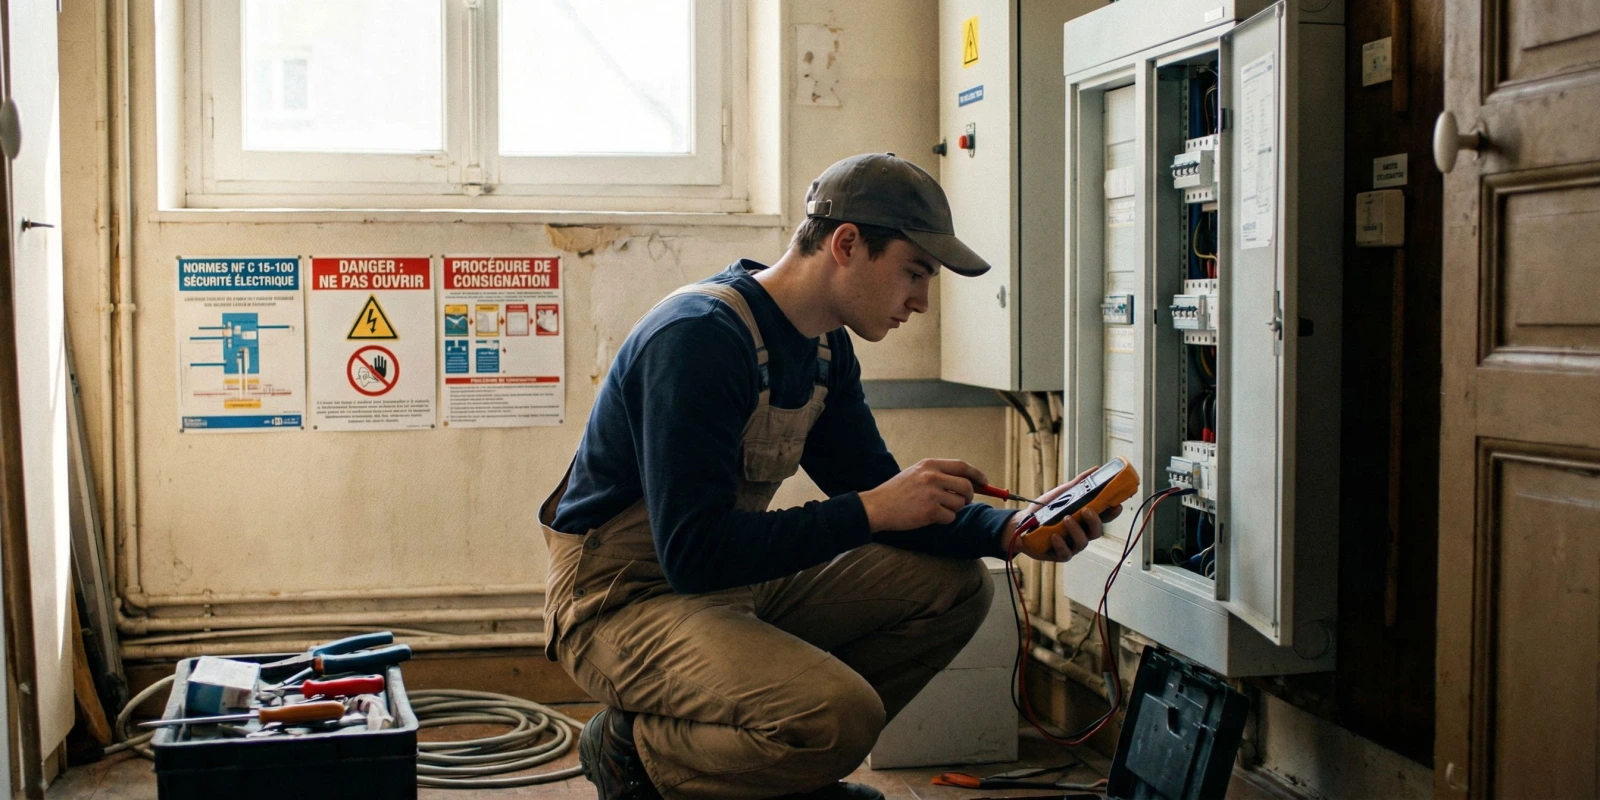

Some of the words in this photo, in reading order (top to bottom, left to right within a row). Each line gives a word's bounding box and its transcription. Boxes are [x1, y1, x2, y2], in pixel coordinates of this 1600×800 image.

[183, 262, 228, 273] NORMES
[231, 262, 245, 273] NF
[247, 262, 255, 273] C
[258, 262, 294, 273] 15-100
[339, 260, 395, 273] DANGER
[399, 262, 403, 273] :
[452, 257, 530, 273] PROCÉDURE
[534, 260, 551, 273] DE
[183, 274, 232, 287] SÉCURITÉ
[234, 273, 294, 287] ÉLECTRIQUE
[319, 275, 338, 288] NE
[341, 275, 369, 288] PAS
[372, 275, 424, 288] OUVRIR
[453, 274, 550, 288] CONSIGNATION
